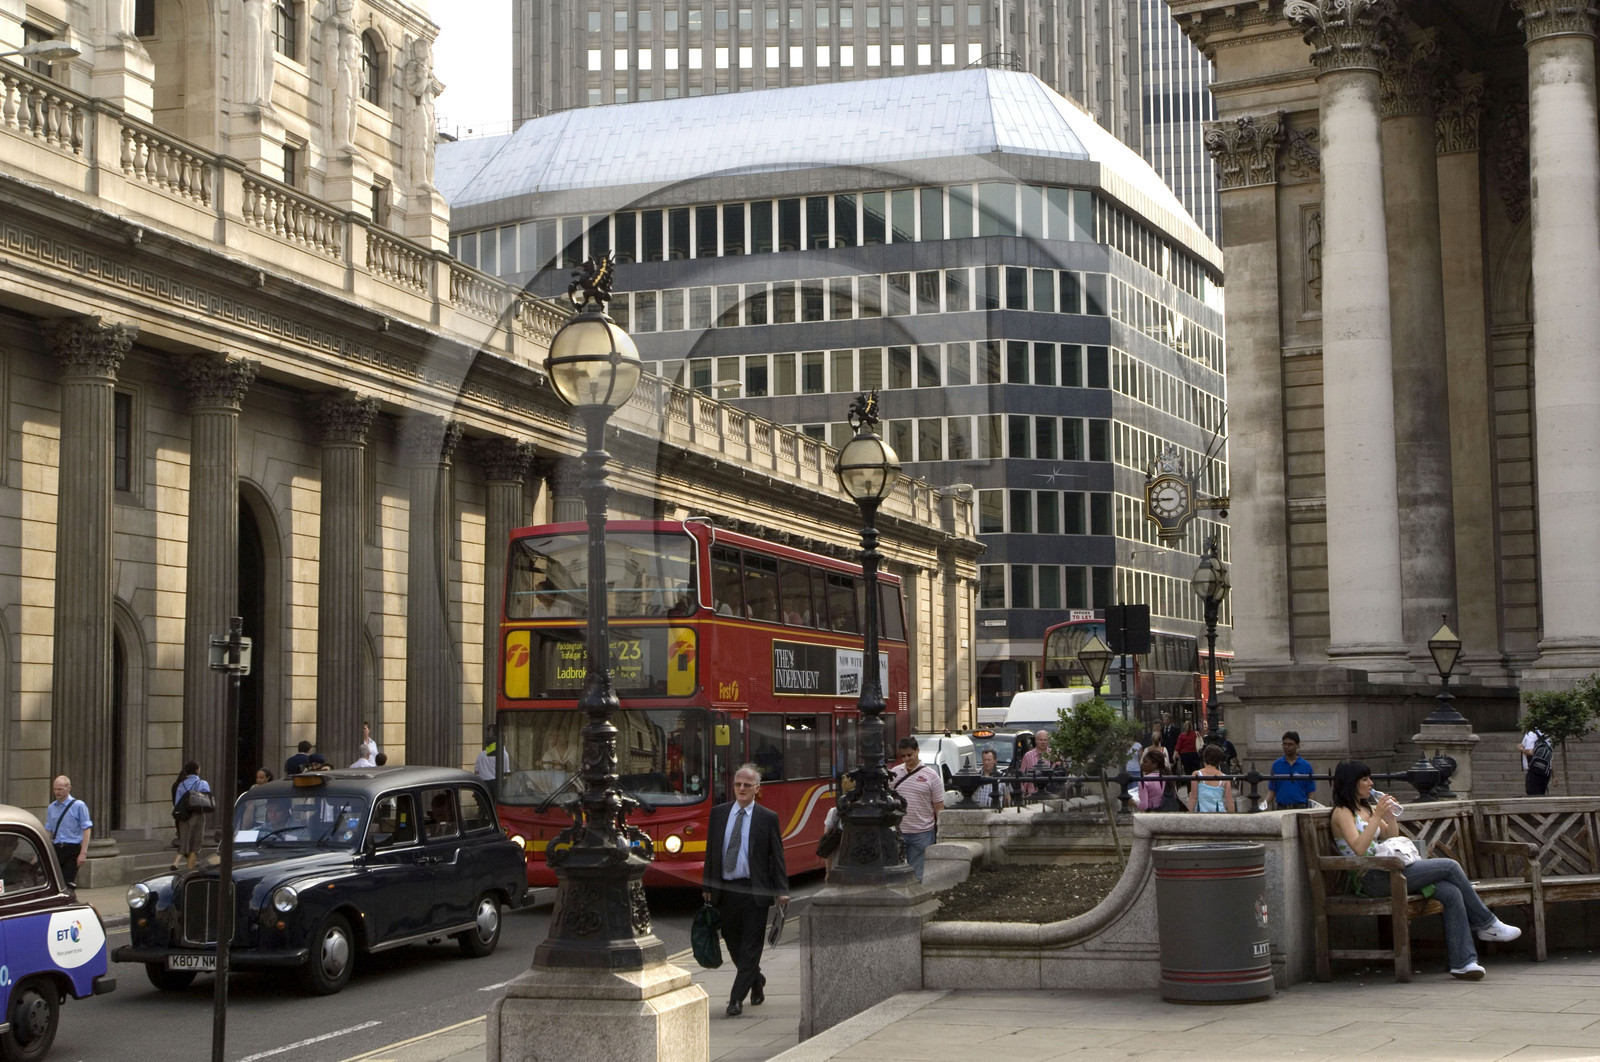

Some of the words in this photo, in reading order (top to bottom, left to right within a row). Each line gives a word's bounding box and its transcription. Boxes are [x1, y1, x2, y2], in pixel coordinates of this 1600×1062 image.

[618, 641, 641, 660] 23
[775, 649, 790, 668] THE
[557, 666, 587, 679] Ladbrok
[775, 669, 820, 689] INDEPENDENT
[57, 929, 69, 941] BT
[172, 956, 200, 967] K807
[202, 956, 216, 967] NM
